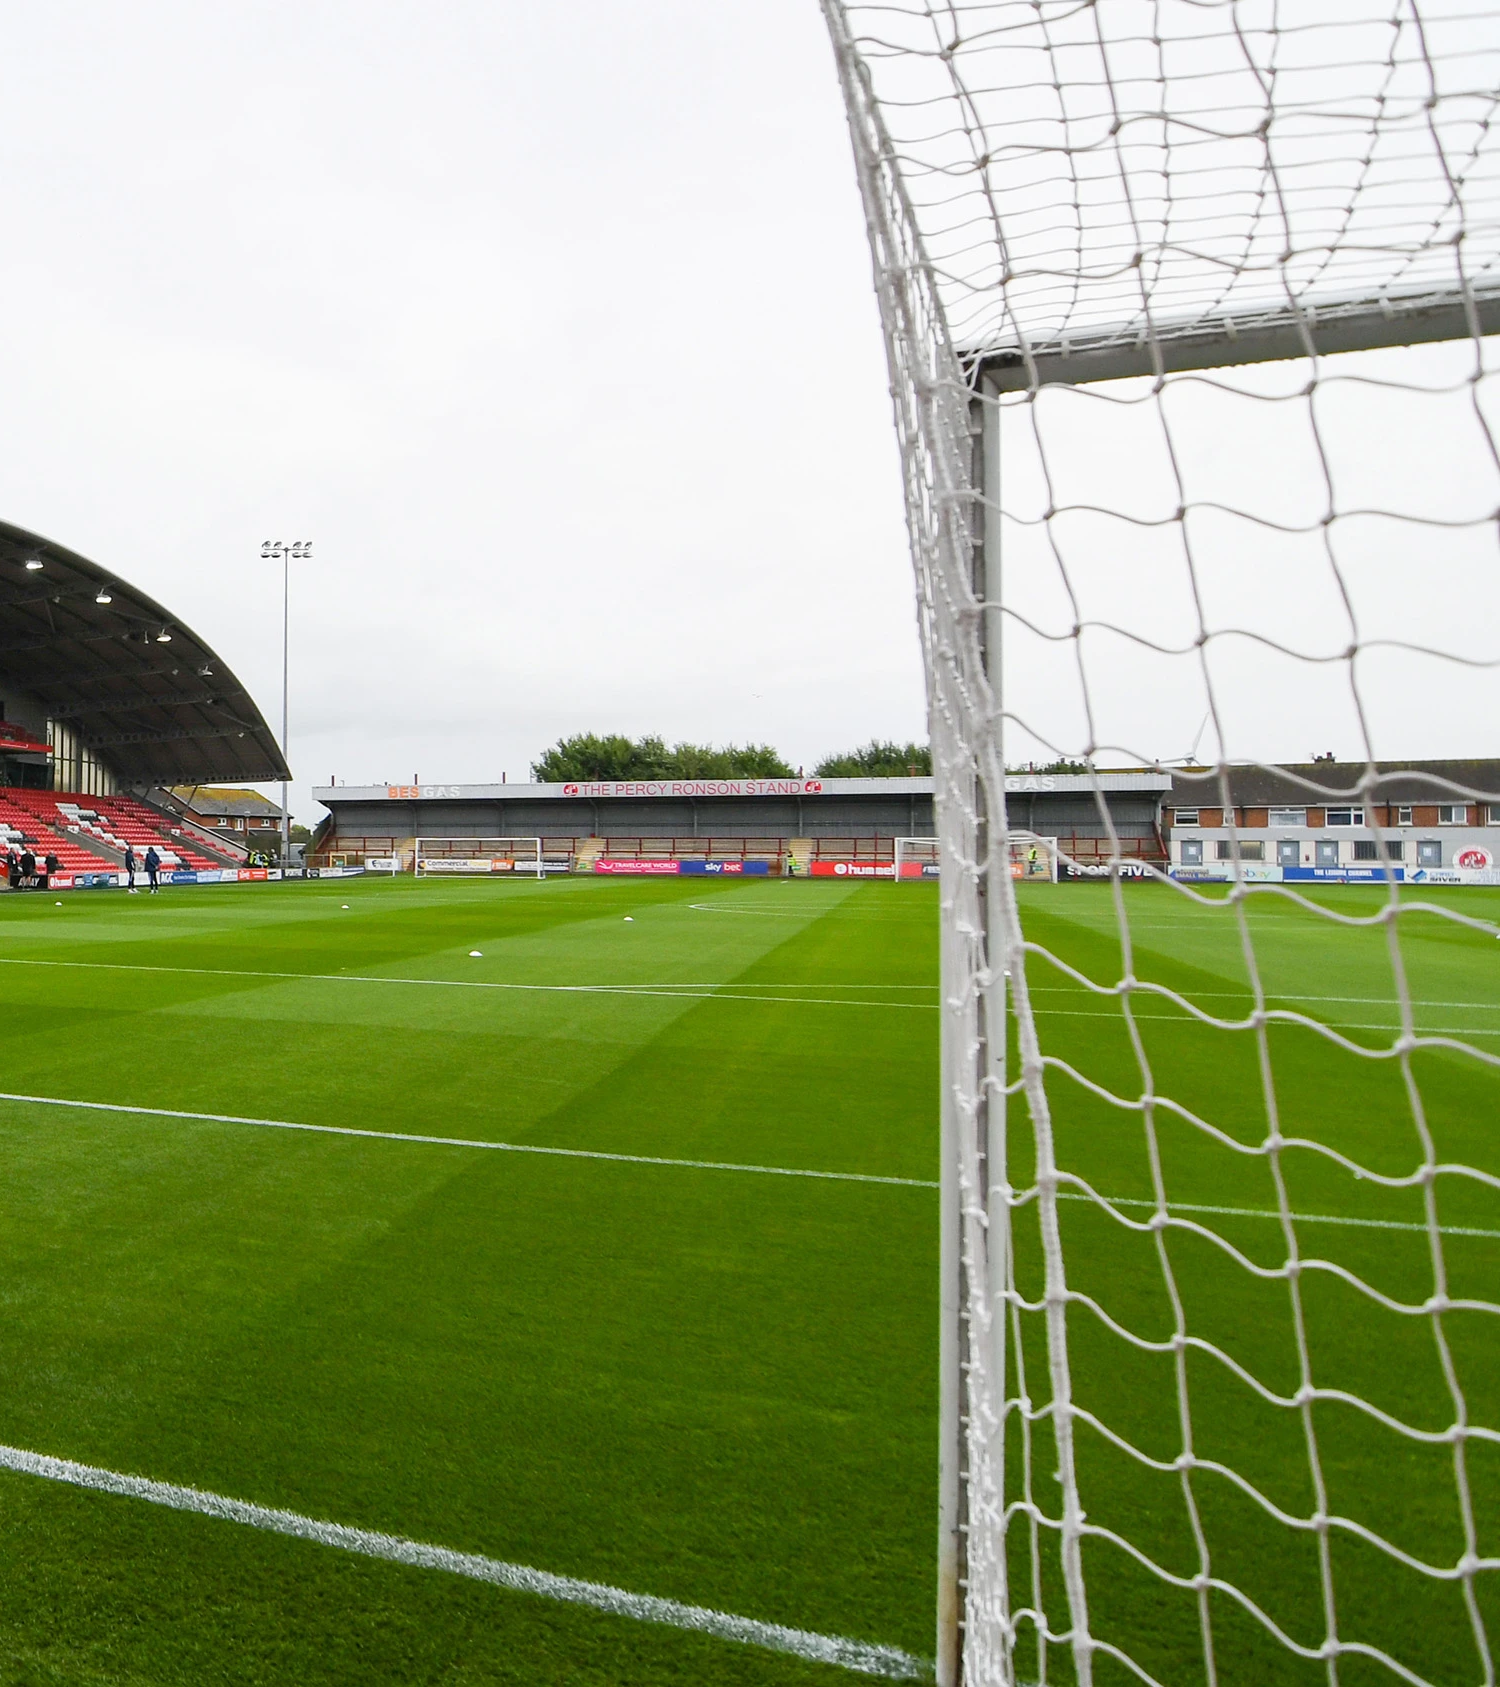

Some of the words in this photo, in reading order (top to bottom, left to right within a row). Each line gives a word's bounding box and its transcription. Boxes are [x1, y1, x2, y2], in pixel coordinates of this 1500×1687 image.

[582, 784, 610, 795] THE
[616, 784, 668, 795] PERCY
[672, 783, 740, 795] RONSON
[746, 782, 800, 794] STAND
[1004, 777, 1056, 791] GAS
[388, 786, 419, 798] BES
[423, 786, 460, 798] GAS
[705, 863, 722, 872] sky
[724, 863, 740, 871] bet
[848, 864, 895, 875] hummel
